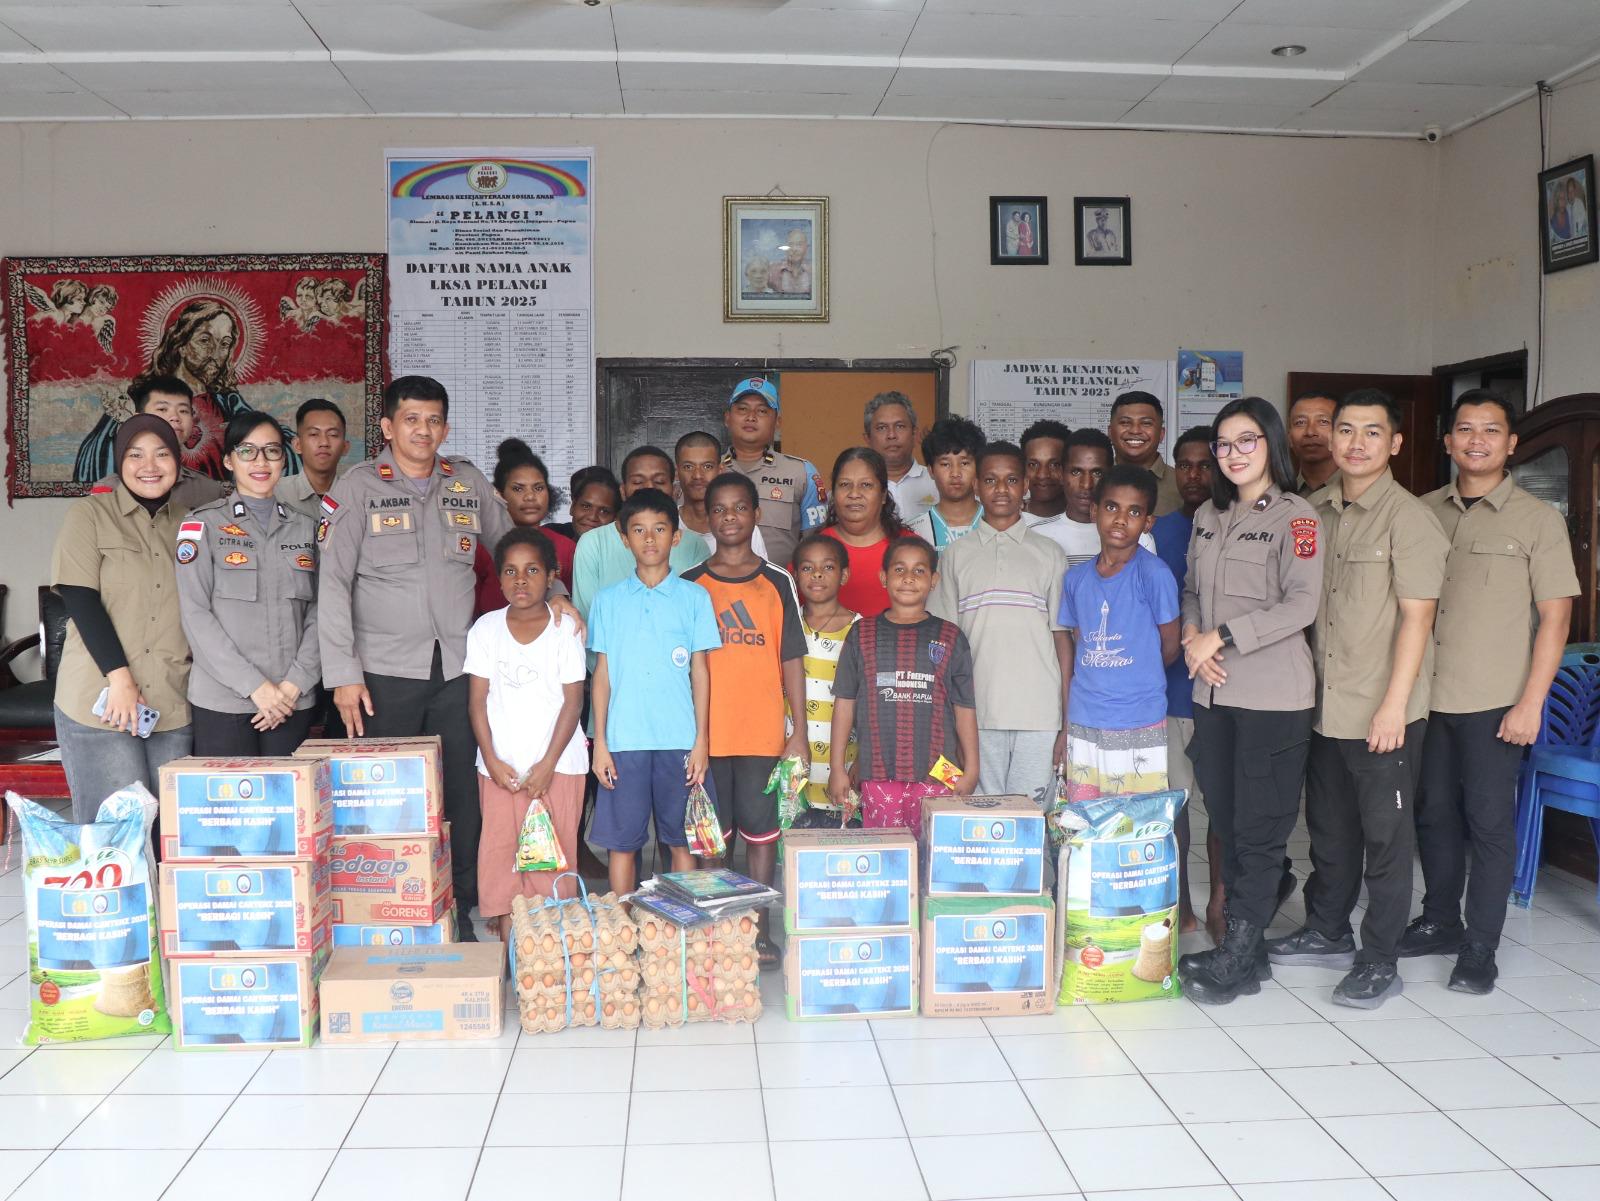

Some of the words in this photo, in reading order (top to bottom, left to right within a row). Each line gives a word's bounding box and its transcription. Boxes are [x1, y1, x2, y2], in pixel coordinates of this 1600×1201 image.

[406, 262, 470, 273] DAFTAR
[475, 262, 525, 273] NAMA
[527, 262, 572, 273] ANAK
[430, 279, 471, 290] LKSA
[476, 279, 548, 290] PELANGI
[441, 296, 496, 306] TAHUN
[501, 296, 537, 306] 2025
[1003, 364, 1059, 373] JADWAL
[1062, 365, 1140, 375] KUNJUNGAN
[1025, 376, 1058, 385] LKSA
[1062, 376, 1119, 386] PELANGI
[1033, 387, 1077, 396] TAHUN
[1081, 387, 1110, 396] 2025
[761, 476, 793, 486] POLRI
[369, 500, 379, 509] A.
[380, 497, 411, 509] AKBAR
[442, 497, 478, 509] POLRI
[1292, 519, 1315, 527] POLDA
[219, 538, 240, 546] CITRA
[1237, 531, 1274, 543] POLRI
[895, 671, 906, 680] PT
[912, 693, 933, 701] PAPUA
[179, 807, 212, 815] OPERASI
[213, 806, 237, 814] DAMAI
[401, 844, 421, 856] 20
[934, 846, 965, 854] OPERASI
[966, 846, 988, 854] DAMAI
[330, 855, 410, 878] edaap
[1091, 870, 1122, 879] OPERASI
[1123, 869, 1144, 878] DAMAI
[799, 881, 830, 889] OPERASI
[178, 901, 211, 910] OPERASI
[212, 901, 237, 909] DAMAI
[381, 907, 428, 918] GORENG
[38, 920, 66, 929] OPERASI
[67, 919, 91, 929] DAMAI
[936, 946, 967, 954] OPERASI
[801, 968, 832, 977] OPERASI
[834, 967, 857, 975] DAMAI
[182, 996, 215, 1004] OPERASI
[216, 995, 241, 1003] DAMAI
